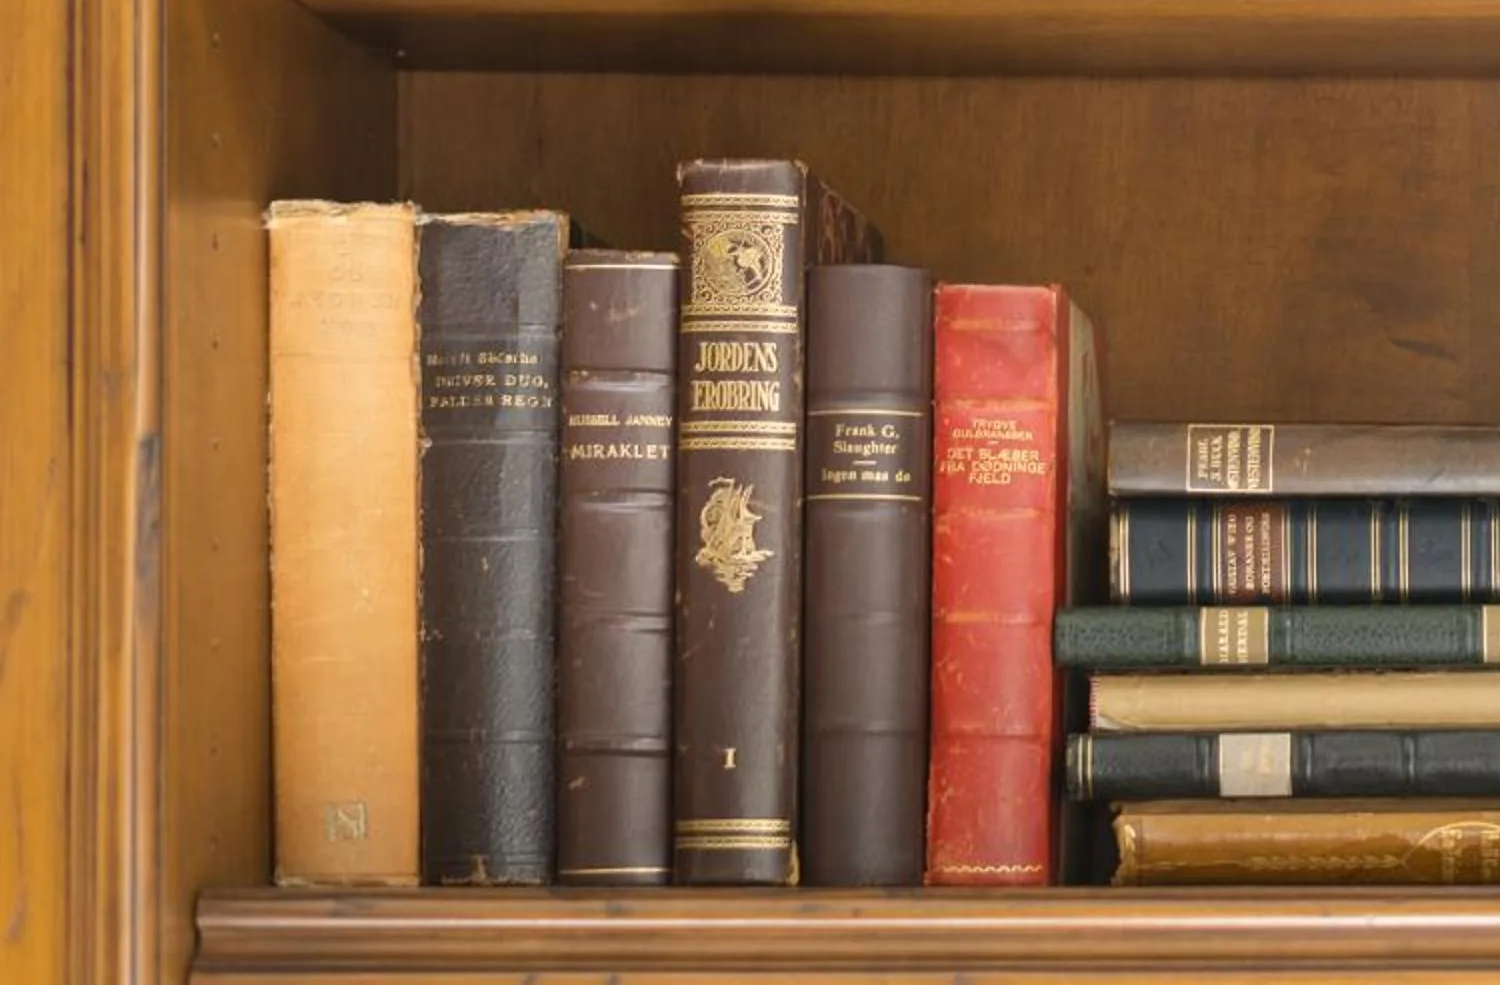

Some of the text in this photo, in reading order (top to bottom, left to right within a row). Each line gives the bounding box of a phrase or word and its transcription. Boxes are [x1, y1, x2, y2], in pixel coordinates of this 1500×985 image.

[695, 342, 777, 372] JORDENS
[691, 380, 780, 412] EROBRING
[625, 414, 673, 427] JANNEY
[835, 424, 900, 439] Frank G.
[570, 444, 670, 460] MIRAKLET
[833, 440, 898, 456] Slaughter
[1197, 438, 1209, 479] PEARL
[821, 468, 857, 483] Ingen
[969, 472, 1012, 484] FJELD
